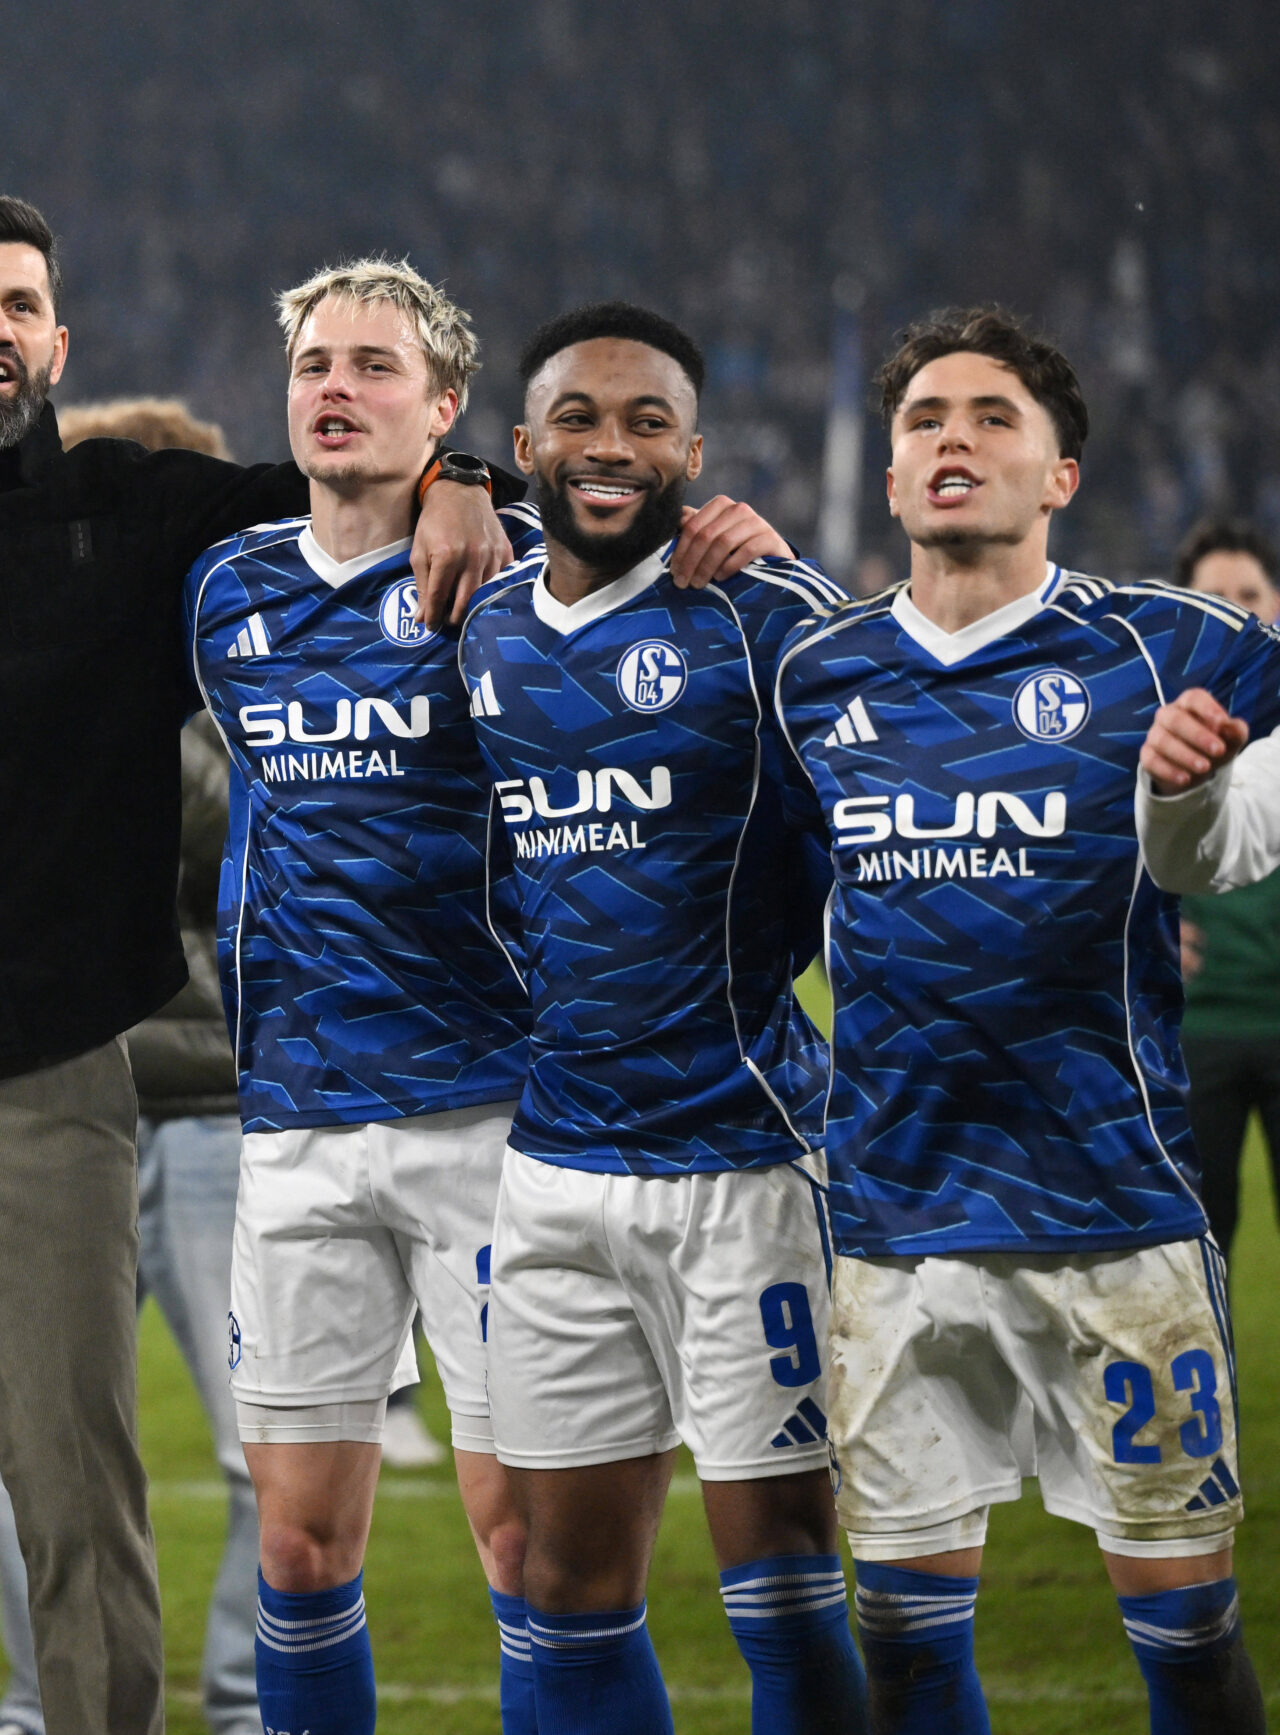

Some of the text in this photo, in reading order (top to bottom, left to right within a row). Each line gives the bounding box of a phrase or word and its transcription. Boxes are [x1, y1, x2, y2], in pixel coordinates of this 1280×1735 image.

[238, 696, 430, 747] SUN
[261, 749, 405, 783] MINIMEAL
[494, 765, 672, 823] SUN
[832, 791, 1067, 846] SUN
[513, 820, 647, 859] MINIMEAL
[857, 847, 1036, 882] MINIMEAL
[758, 1282, 821, 1388] 9
[1103, 1348, 1224, 1465] 23
